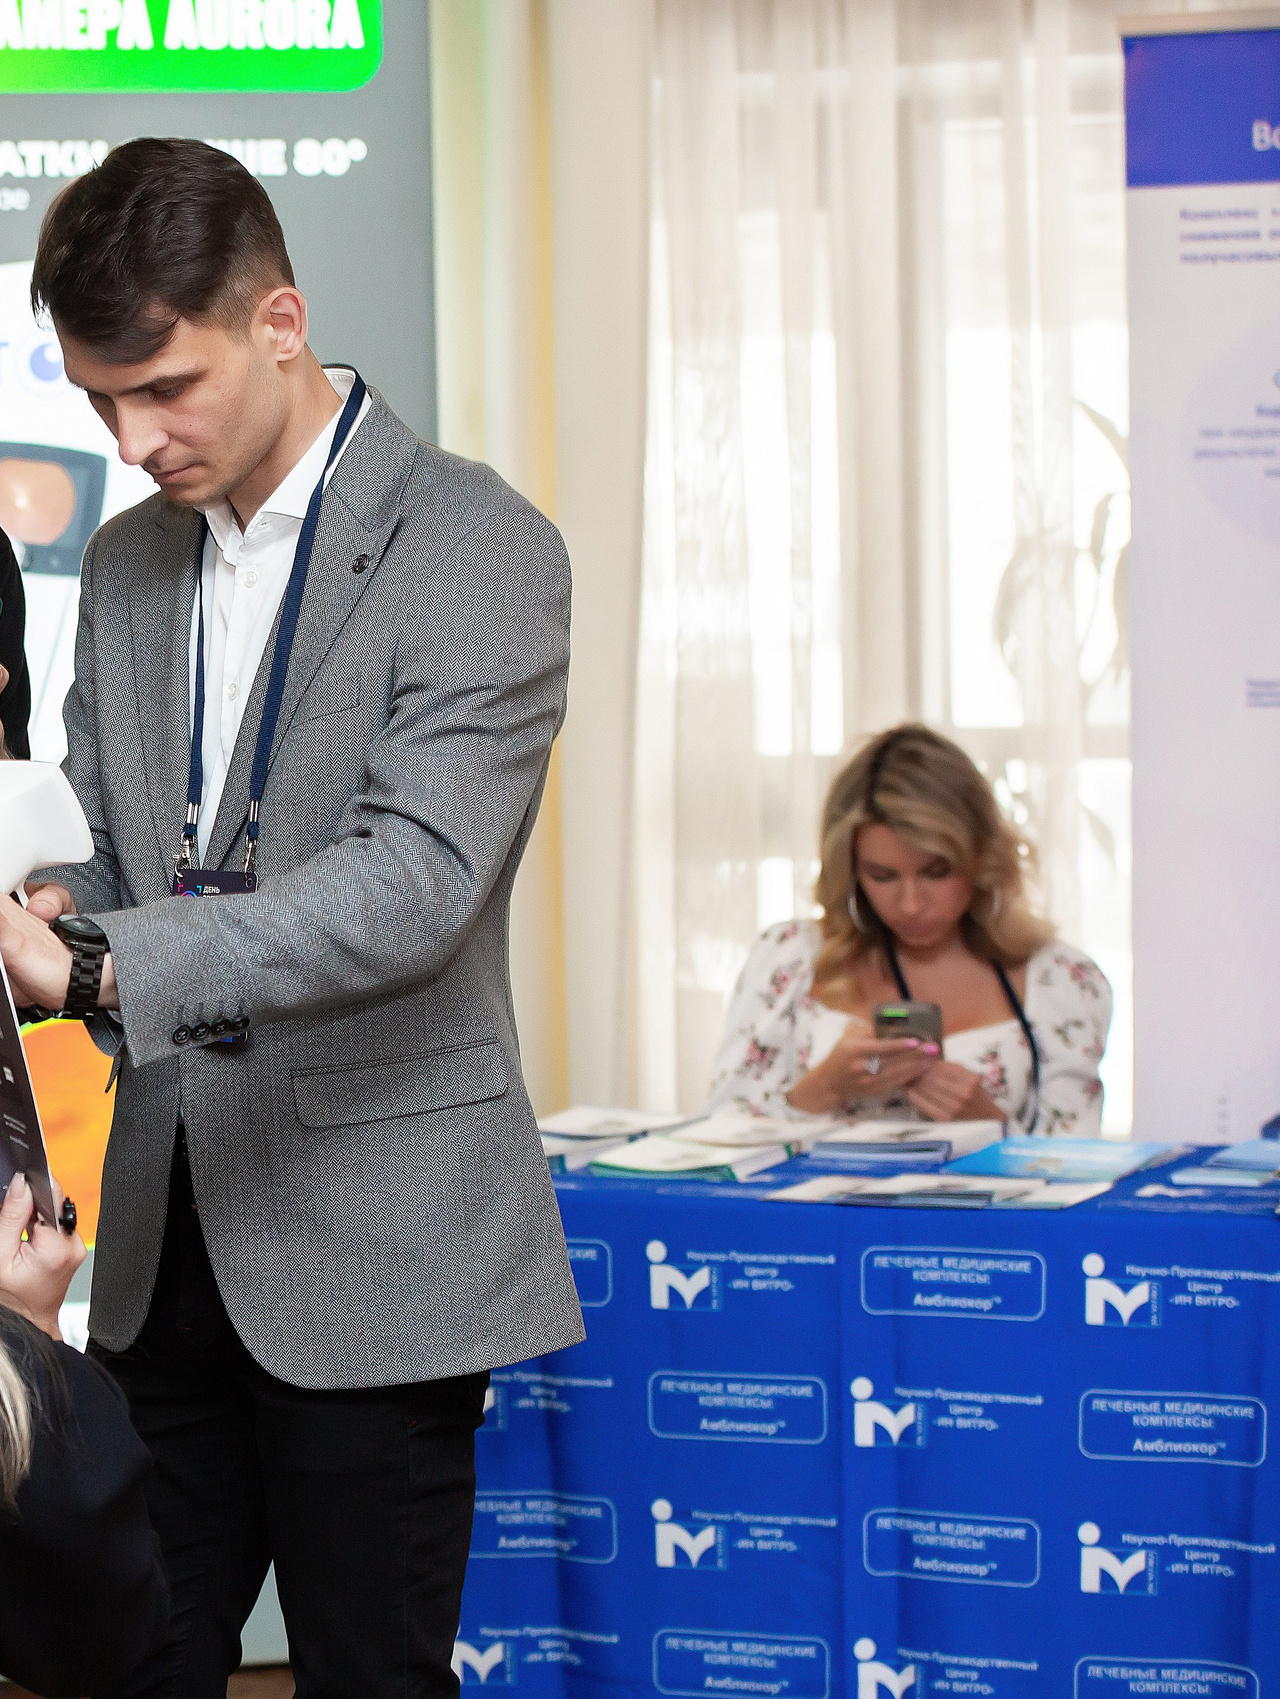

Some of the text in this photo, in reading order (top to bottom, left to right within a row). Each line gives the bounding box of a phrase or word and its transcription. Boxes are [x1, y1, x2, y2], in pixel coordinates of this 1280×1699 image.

[163, 0, 365, 49] AURORA
[203, 886, 220, 894] ДЕНЬ
[1092, 1399, 1254, 1419] ЛЕЧЕБНЫЕ МЕДИЦИНСКИЕ
[1122, 1533, 1276, 1553] Научно-Производственный
[1185, 1550, 1220, 1563] Центр
[1088, 1665, 1246, 1689] ЛЕЧЕБНЫЕ МЕДИЦИНСКИЕ
